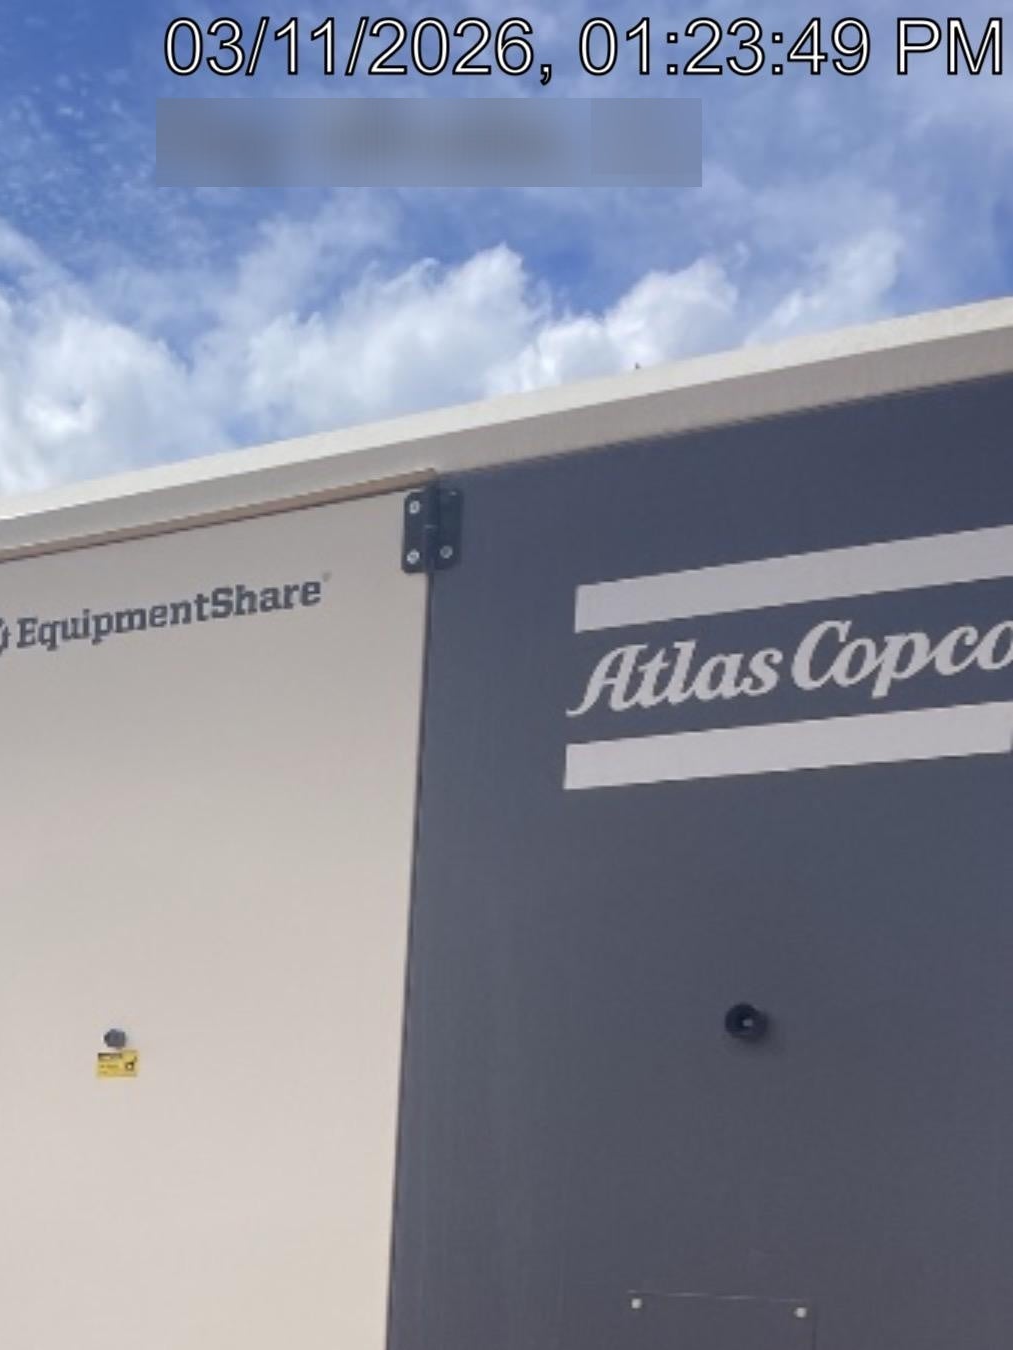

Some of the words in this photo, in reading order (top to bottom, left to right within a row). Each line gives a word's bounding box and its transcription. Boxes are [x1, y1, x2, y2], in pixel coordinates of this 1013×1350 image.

[16, 579, 322, 652] EquipmentShare
[565, 638, 784, 719] Atlas
[791, 618, 1013, 700] Copco
